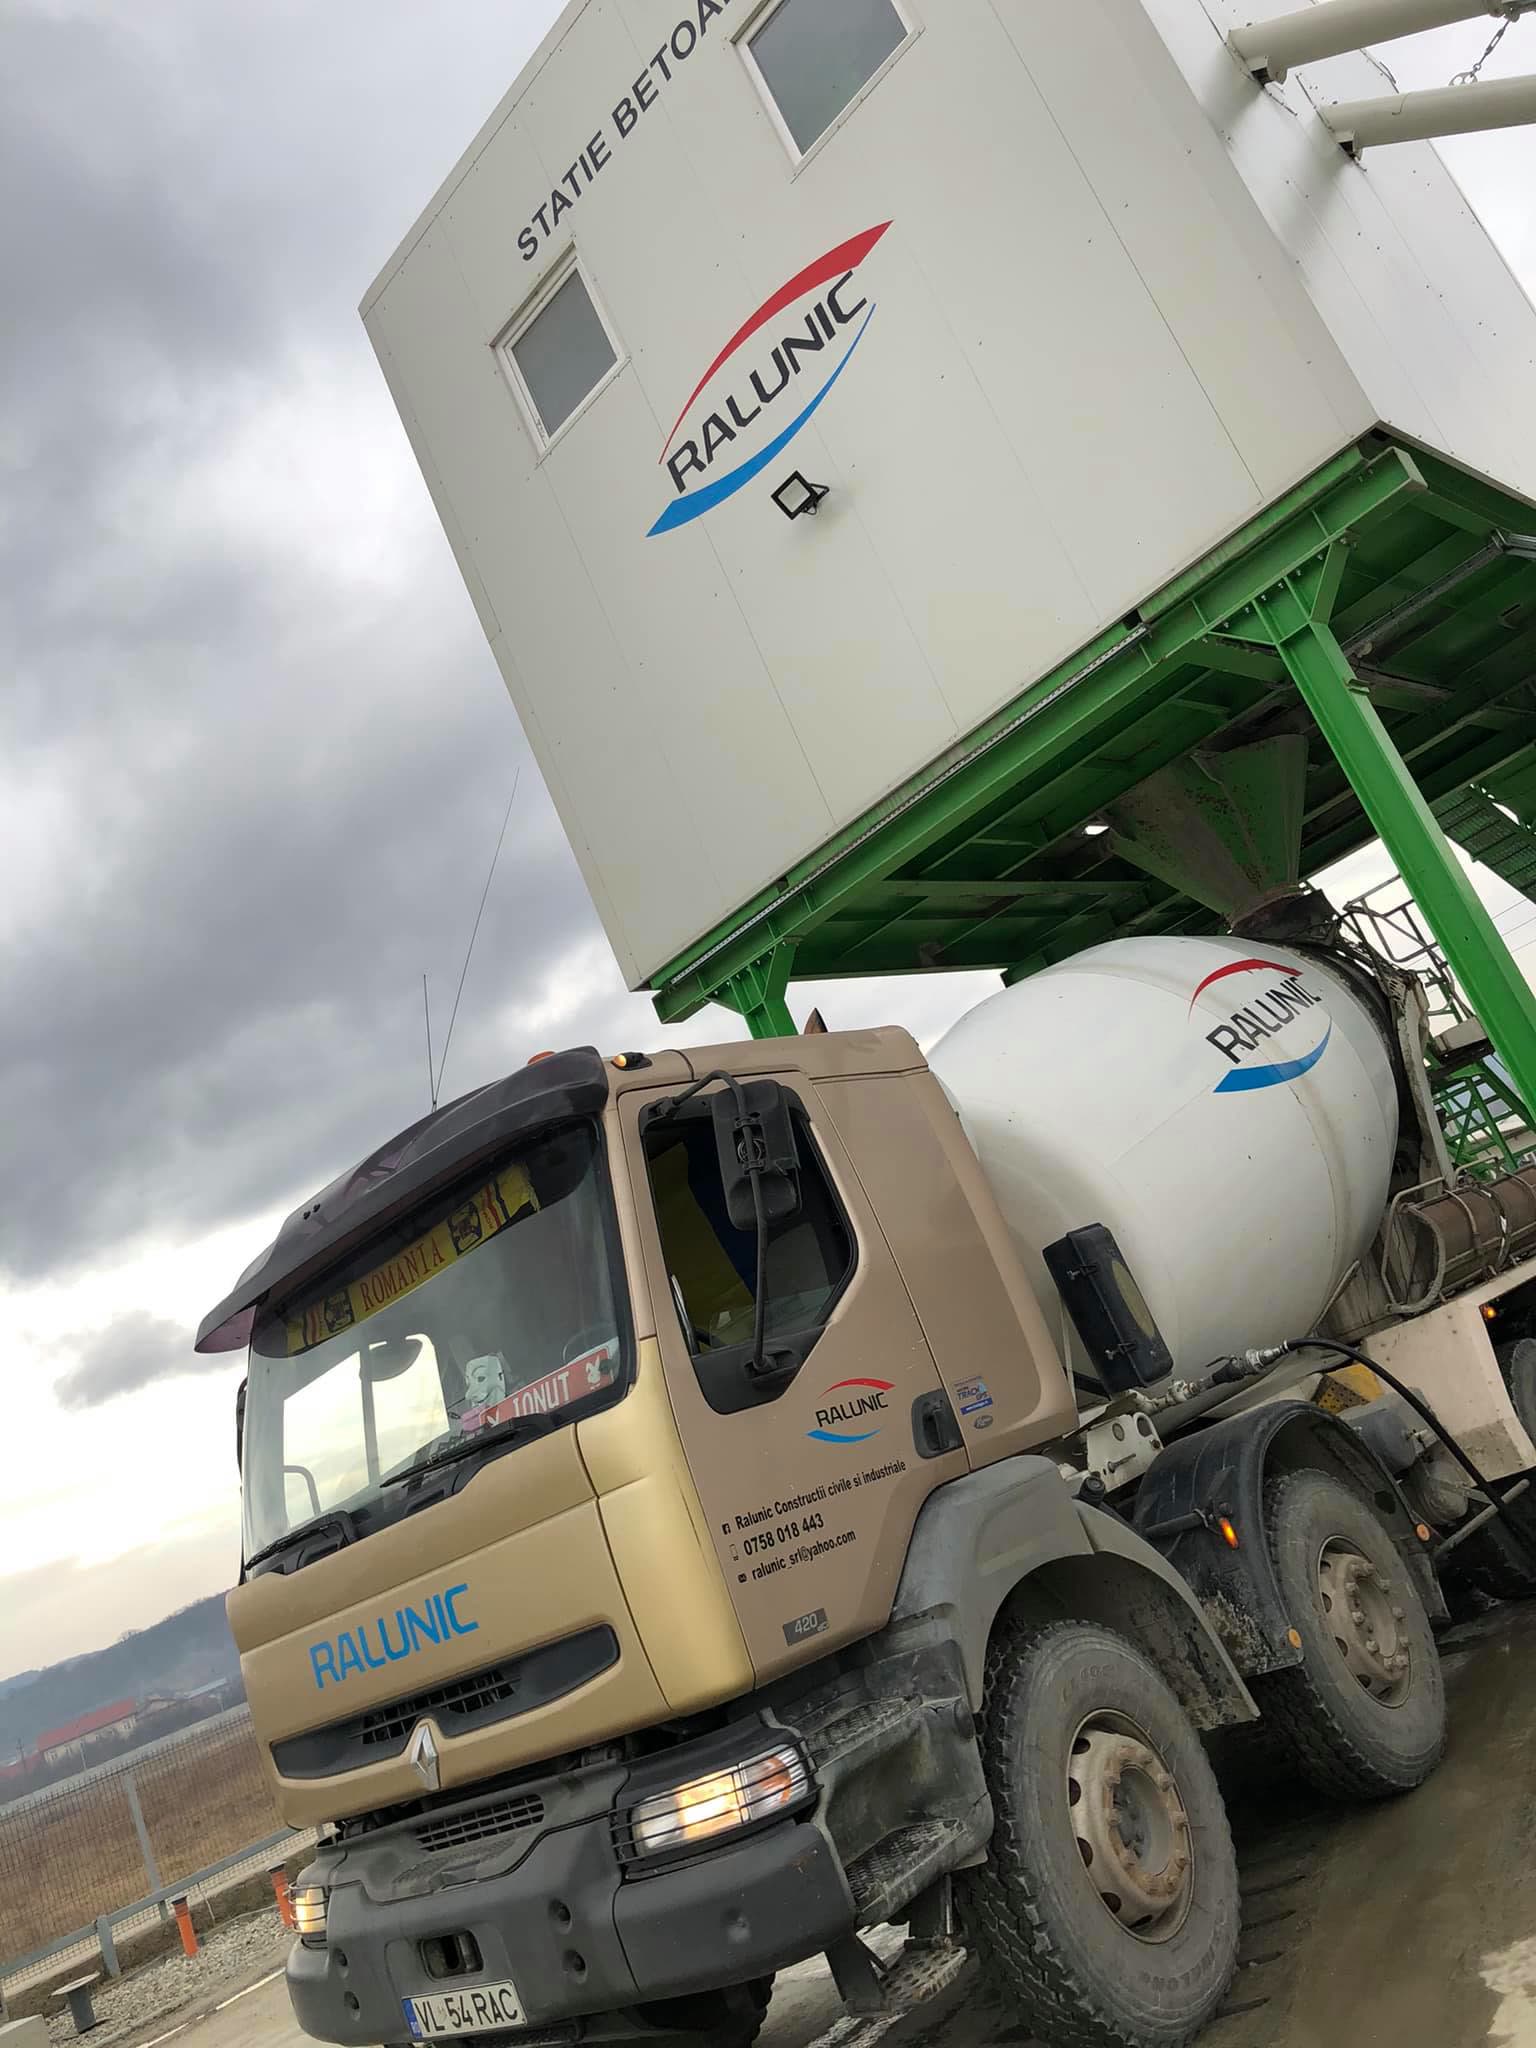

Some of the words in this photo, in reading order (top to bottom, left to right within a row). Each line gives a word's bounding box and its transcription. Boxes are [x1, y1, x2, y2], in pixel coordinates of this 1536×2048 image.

[516, 130, 612, 261] STATIE
[611, 0, 730, 139] BETOA
[666, 270, 868, 494] RALUNIC
[1205, 976, 1323, 1065] RALUNIC
[360, 1237, 446, 1313] ROMANIA
[815, 1391, 889, 1428] RALUNIC
[734, 1507, 774, 1531] Ralunic
[774, 1485, 827, 1516] Constructii
[827, 1478, 852, 1498] civile
[852, 1474, 862, 1488] si
[863, 1459, 906, 1485] industriale
[743, 1531, 775, 1556] 0758
[776, 1521, 800, 1545] 018
[802, 1512, 824, 1534] 443
[751, 1528, 857, 1581] ralunic_srl@yahoo.com
[309, 1583, 480, 1690] RALUNIC
[794, 1612, 818, 1634] 420
[414, 2000, 446, 2033] VL
[444, 1995, 474, 2028] 54
[470, 1988, 518, 2025] RAC
